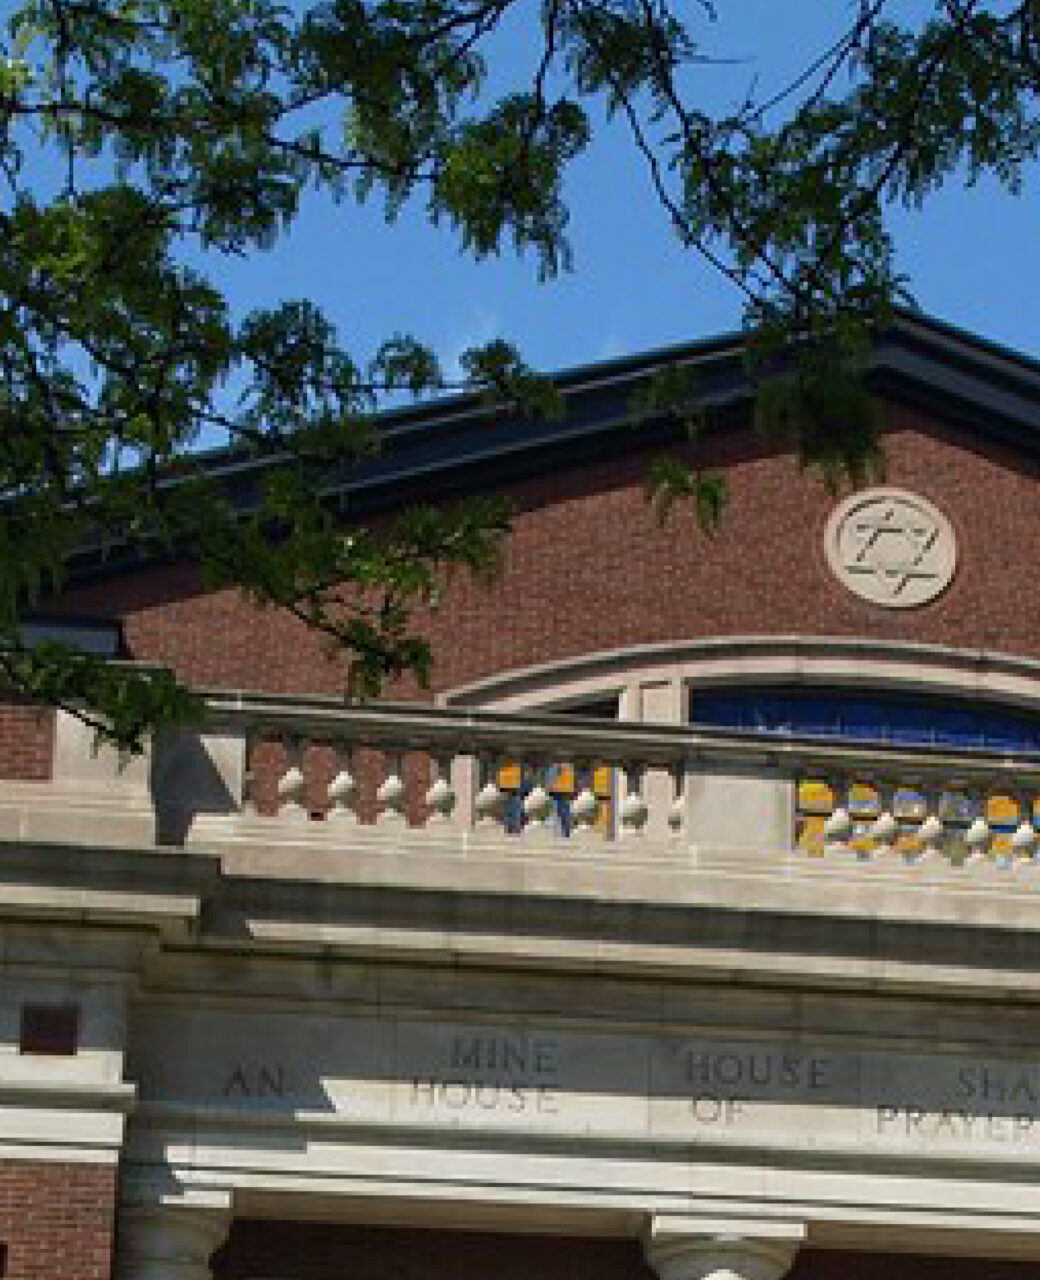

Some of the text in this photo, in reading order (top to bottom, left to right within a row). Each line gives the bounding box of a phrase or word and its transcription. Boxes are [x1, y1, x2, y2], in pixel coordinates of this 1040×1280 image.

[450, 1036, 558, 1074] MINE
[684, 1049, 834, 1091] HOUSE
[223, 1064, 288, 1097] AN
[411, 1077, 560, 1116] HOUSE
[691, 1095, 745, 1124] OF
[876, 1104, 1036, 1143] PRAYER
